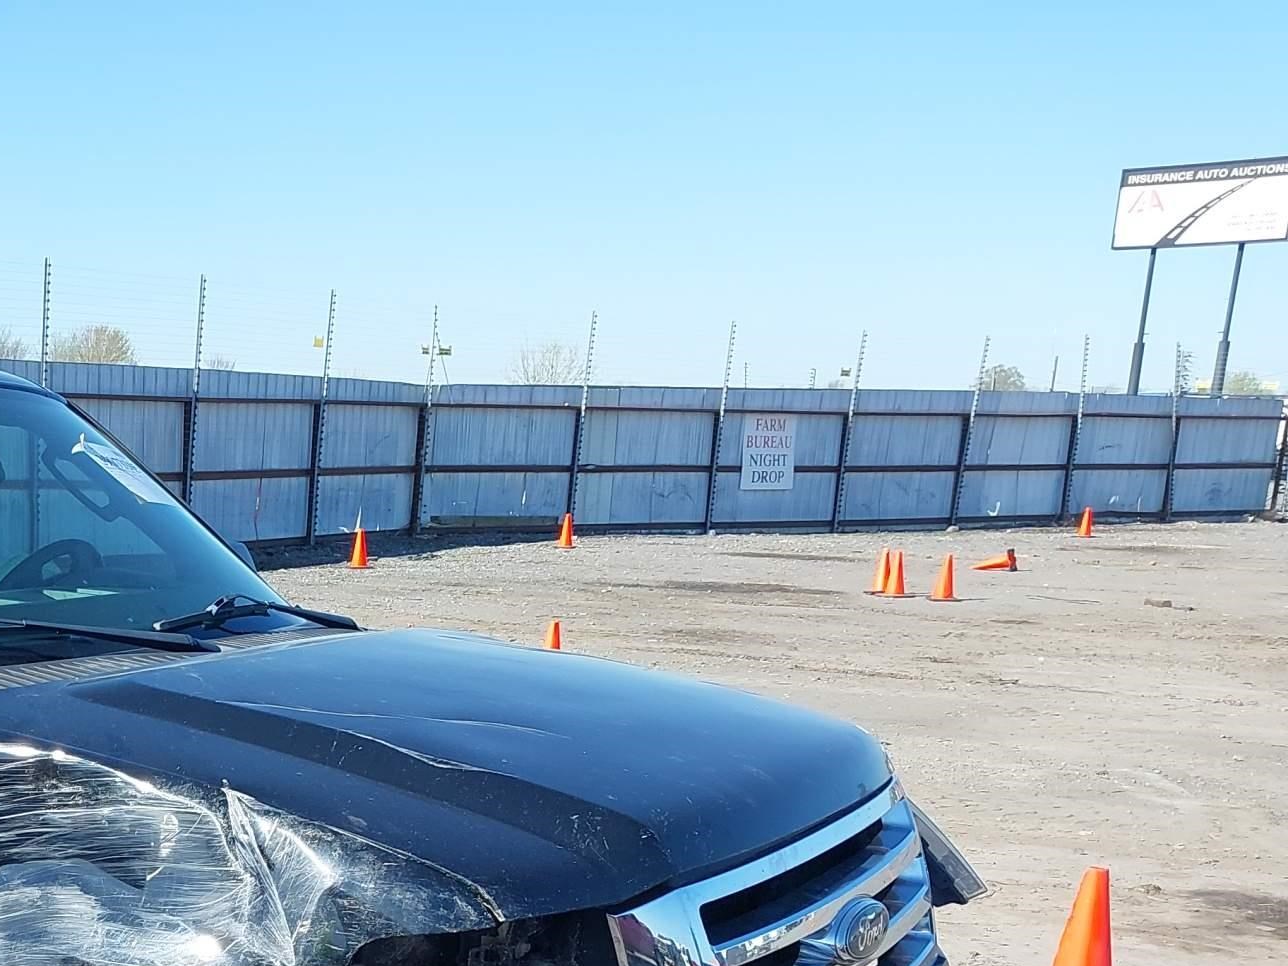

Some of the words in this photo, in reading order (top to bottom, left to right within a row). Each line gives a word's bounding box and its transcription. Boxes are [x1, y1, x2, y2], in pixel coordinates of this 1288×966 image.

[1127, 170, 1194, 185] INSURANCE
[1195, 167, 1229, 180] AUTO
[755, 418, 786, 432] FARM
[746, 435, 792, 448] BUREAU
[749, 453, 788, 467] NIGHT
[751, 470, 785, 483] DROP
